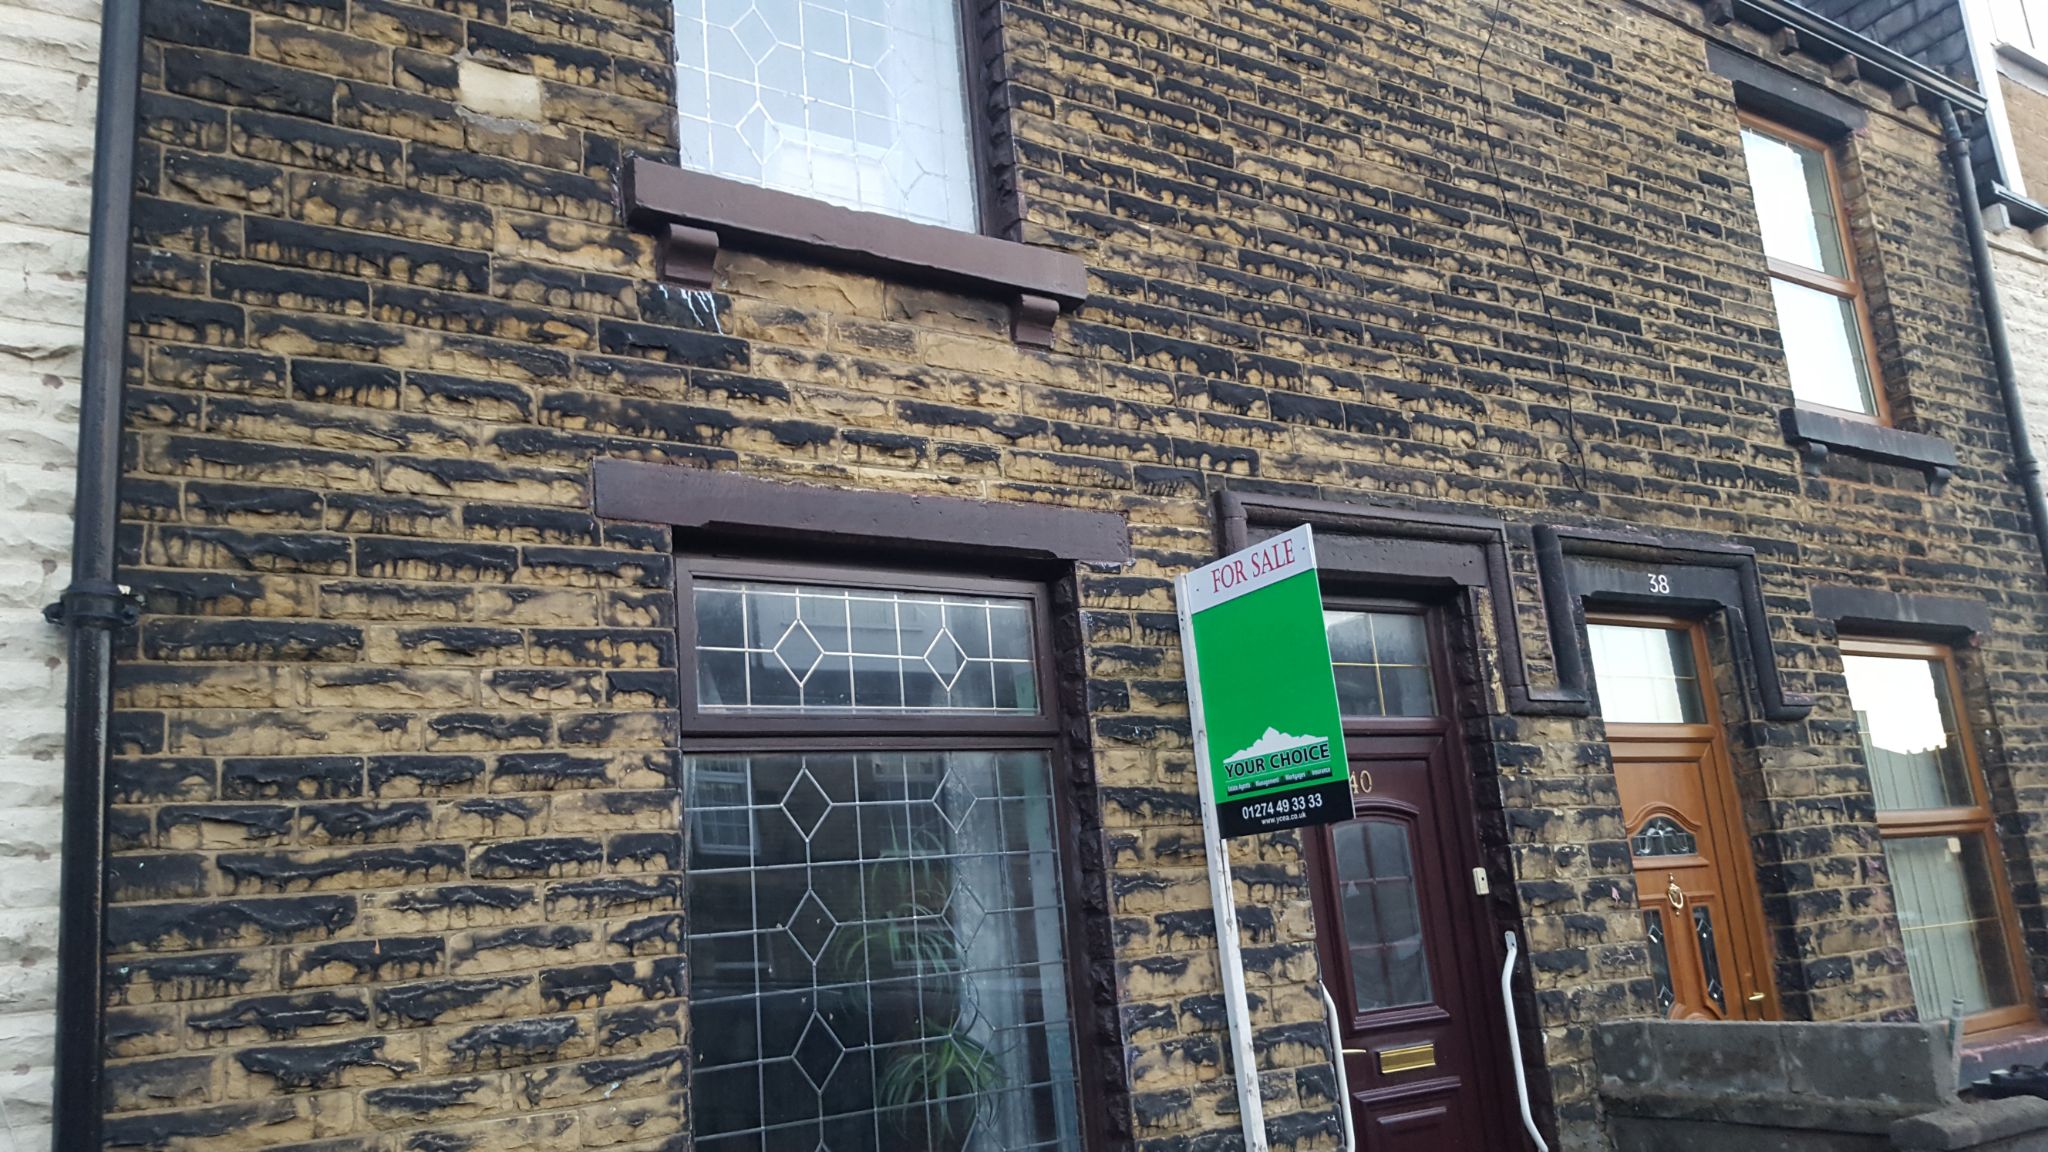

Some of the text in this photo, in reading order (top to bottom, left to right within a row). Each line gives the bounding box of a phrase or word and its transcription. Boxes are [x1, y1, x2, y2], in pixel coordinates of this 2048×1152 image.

[1211, 538, 1296, 594] FOR SALE
[1647, 573, 1670, 594] 38
[1225, 743, 1330, 778] YOUR CHOICE
[1350, 770, 1372, 794] 40
[1241, 792, 1323, 820] 01274 49 33 33
[1261, 811, 1307, 825] www.ycea.co.uk
